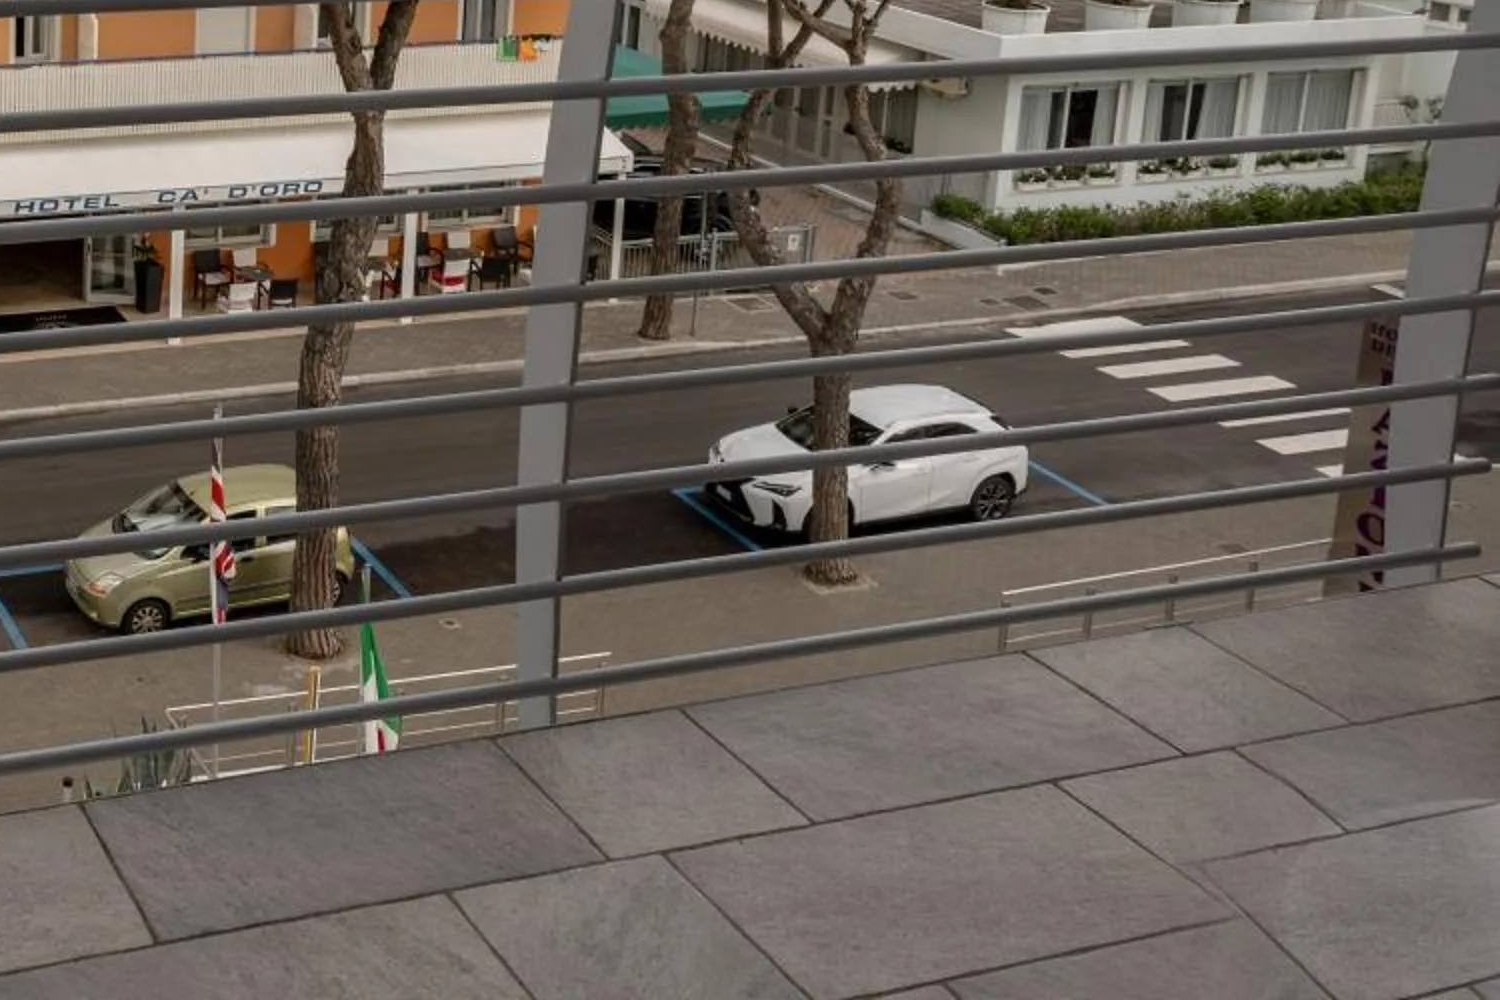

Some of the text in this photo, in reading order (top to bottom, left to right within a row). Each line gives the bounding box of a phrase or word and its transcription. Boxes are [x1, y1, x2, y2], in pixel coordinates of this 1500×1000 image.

[14, 180, 324, 214] HOTEL CA' D'ORO
